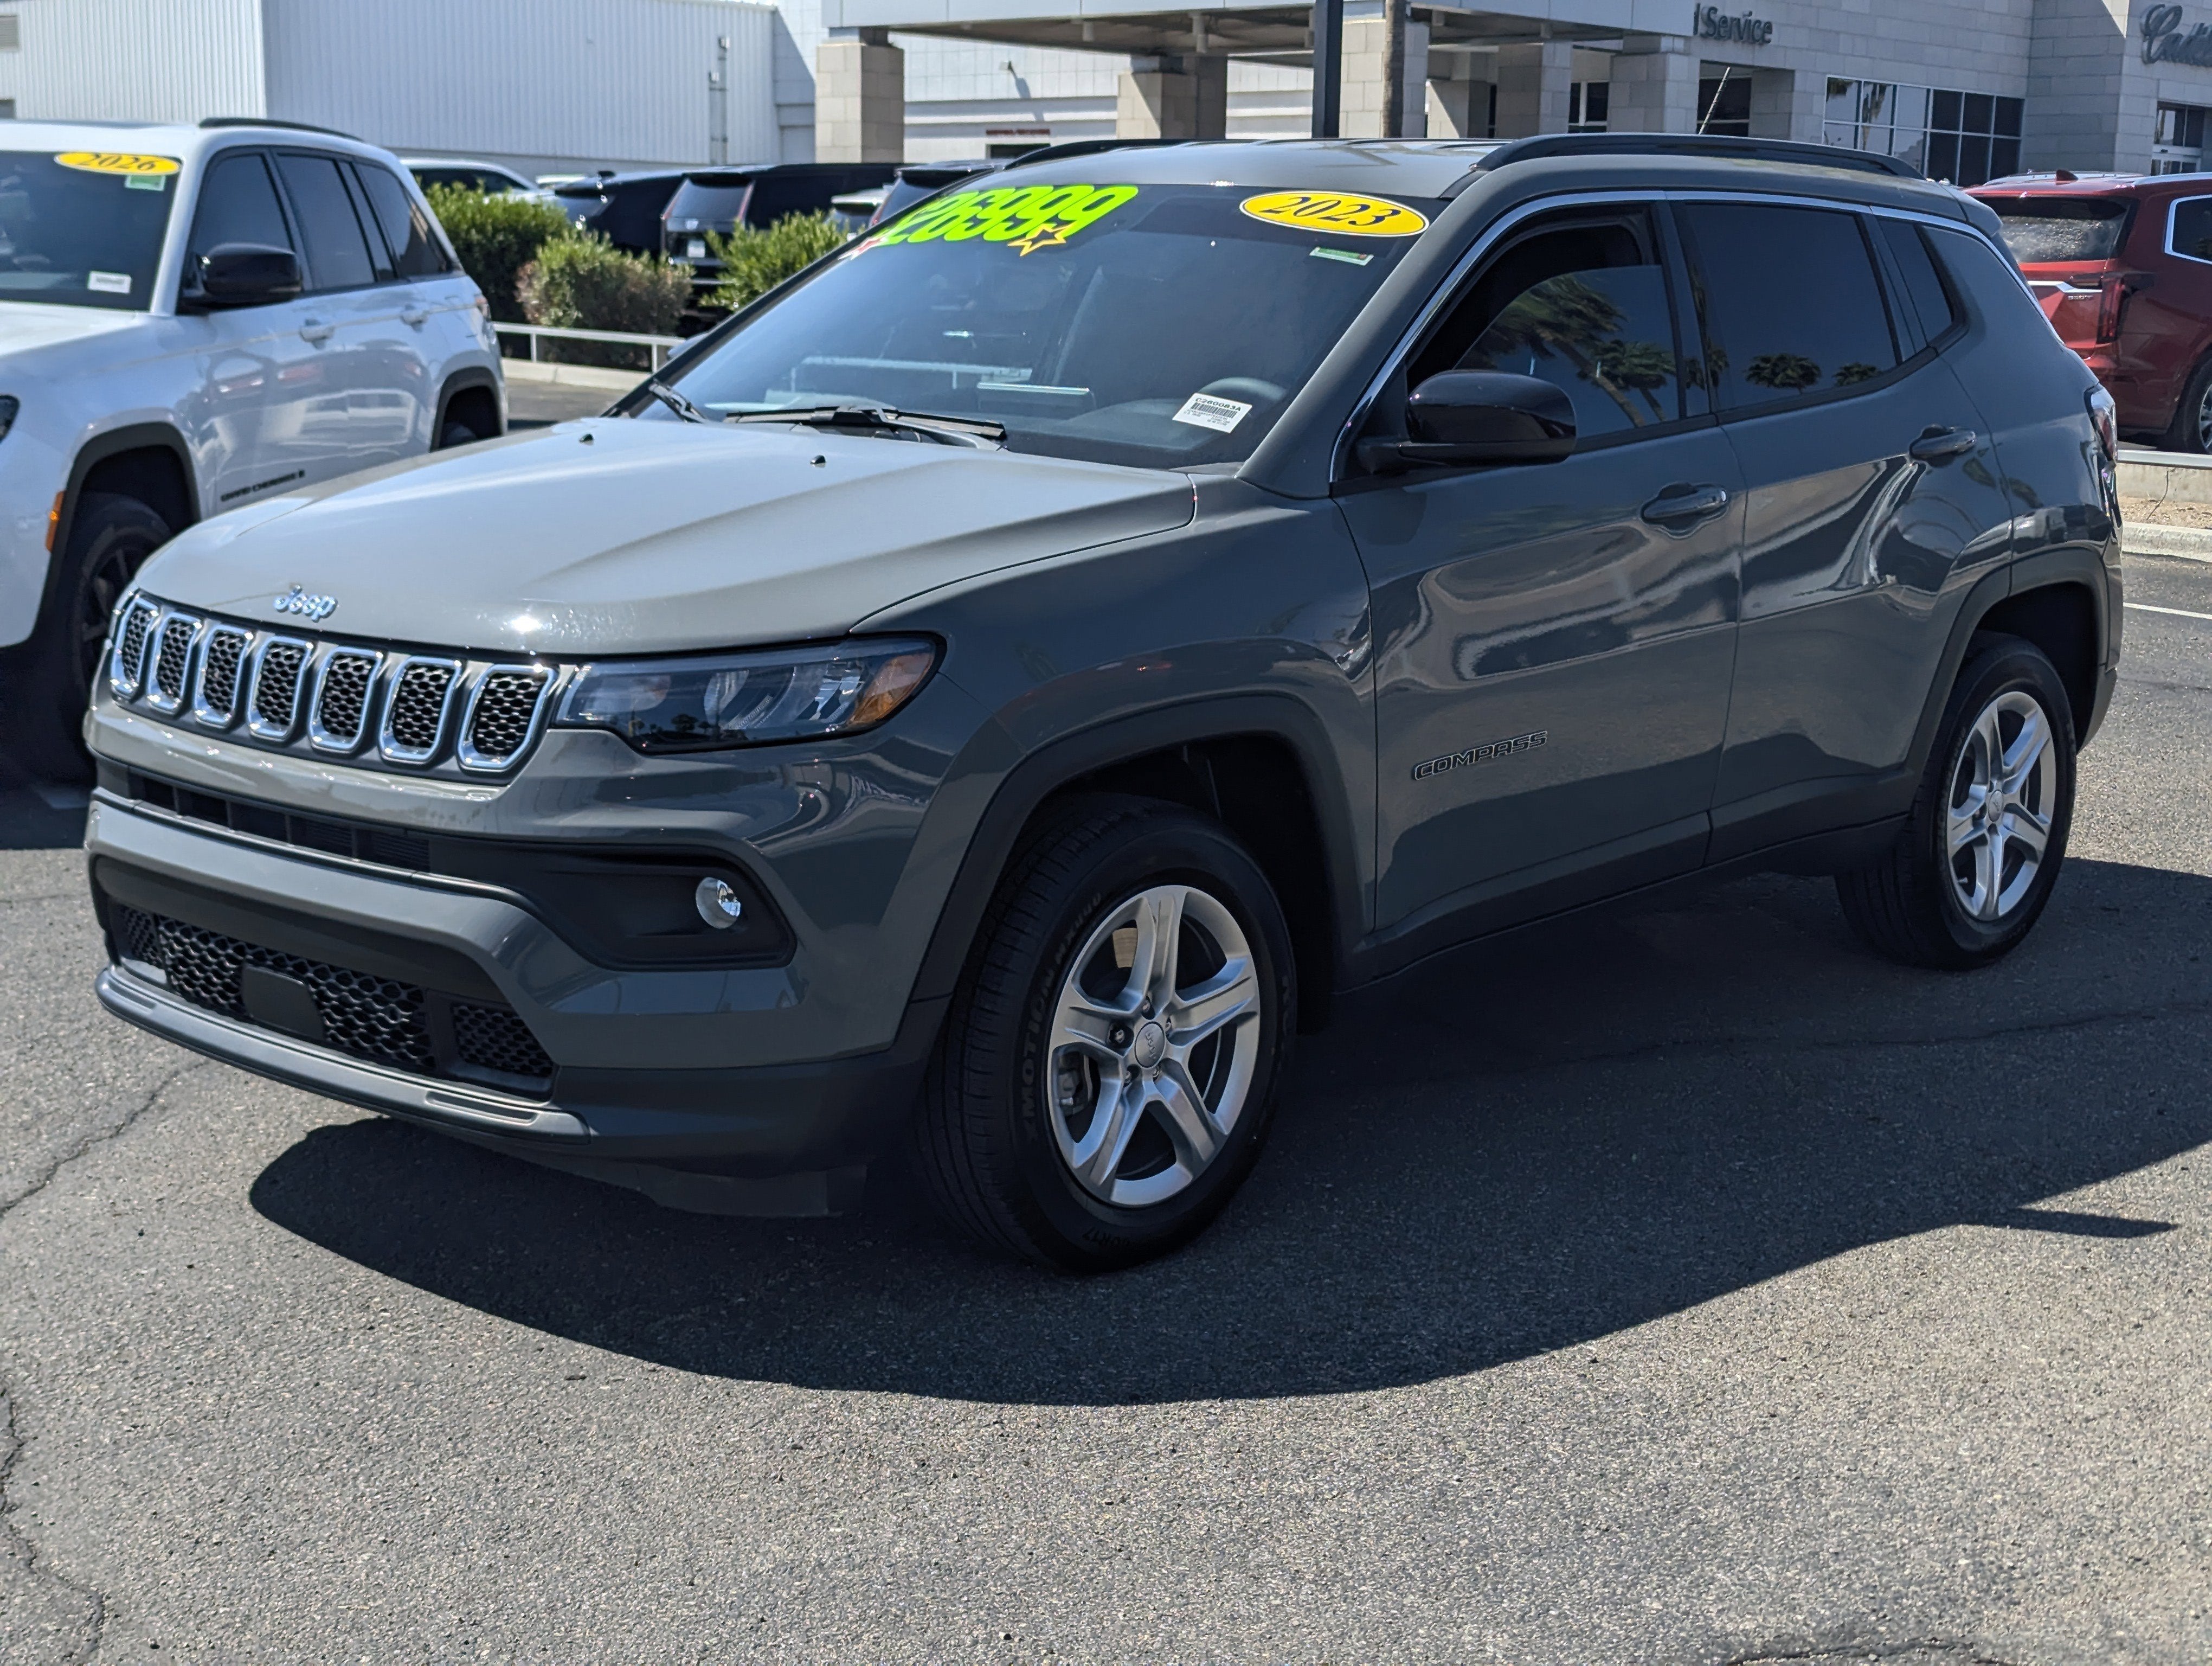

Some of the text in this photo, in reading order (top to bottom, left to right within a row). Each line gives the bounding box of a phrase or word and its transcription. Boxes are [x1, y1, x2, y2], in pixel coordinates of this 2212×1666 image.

[1700, 6, 1773, 44] Service
[76, 152, 161, 171] 2026
[1258, 196, 1401, 226] 2023
[273, 585, 338, 623] Jeep
[1414, 731, 1548, 780] COMPASS
